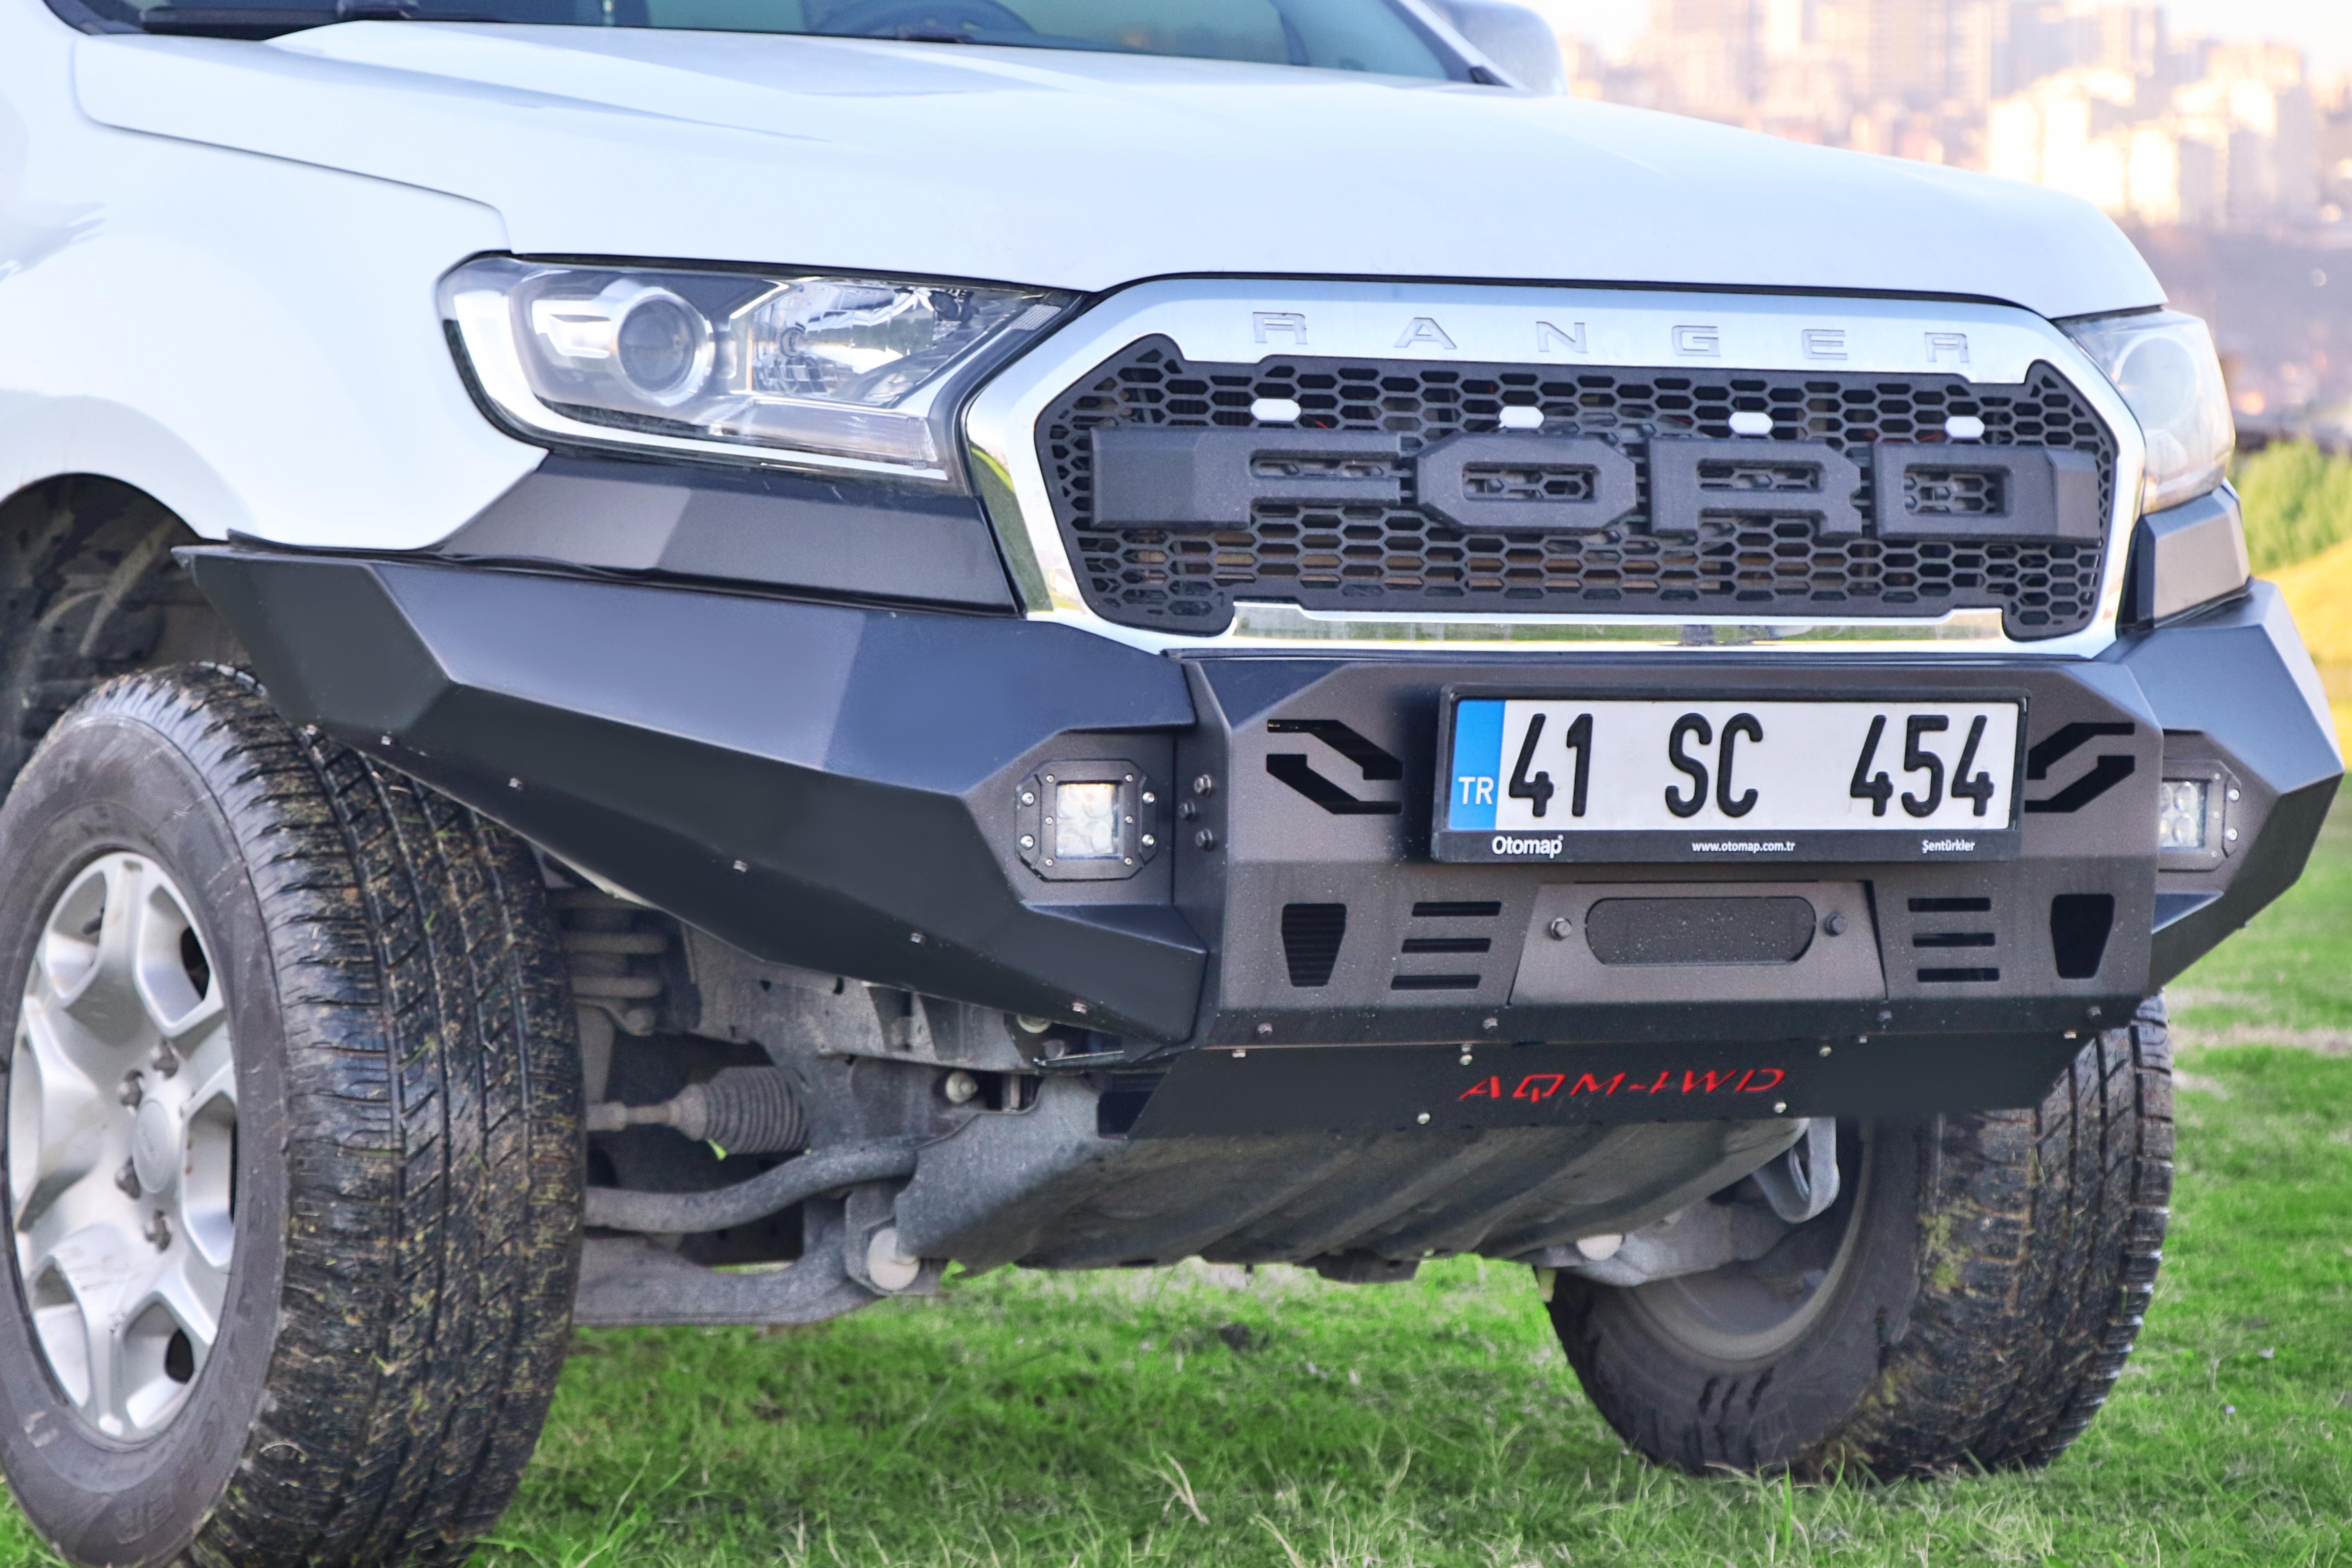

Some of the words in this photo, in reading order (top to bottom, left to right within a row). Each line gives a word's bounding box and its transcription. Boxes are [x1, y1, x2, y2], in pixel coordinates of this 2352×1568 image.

[1252, 312, 1970, 364] RANGER
[1091, 427, 2100, 545] FORD
[1509, 714, 1593, 817] 41
[1665, 713, 1763, 818] SC
[1850, 715, 1993, 817] 454
[1458, 777, 1494, 804] TR
[1492, 835, 1563, 858] Otomap
[1692, 841, 1796, 853] www.otomap.com.tr
[1922, 838, 1975, 854] Şentürkler
